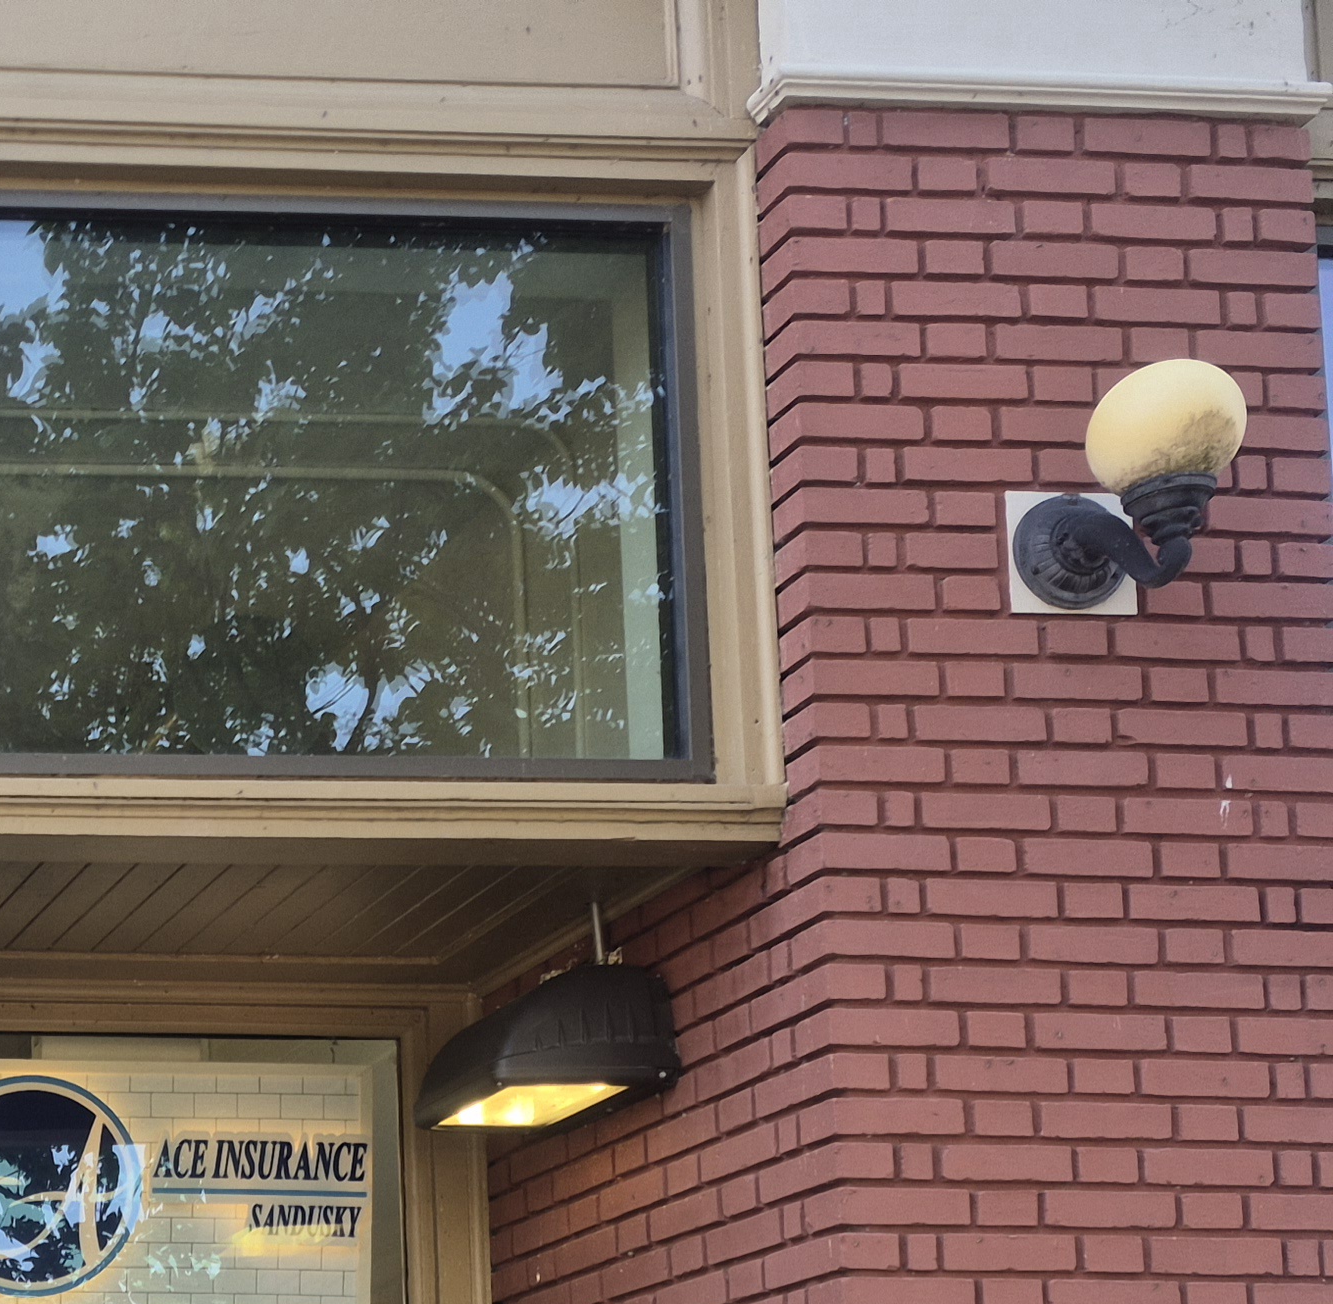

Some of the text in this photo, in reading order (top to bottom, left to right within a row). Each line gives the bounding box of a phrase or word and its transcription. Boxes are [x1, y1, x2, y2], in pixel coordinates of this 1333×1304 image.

[153, 1138, 368, 1182] ACE INSURANCE
[249, 1204, 362, 1238] SANDUSKY
